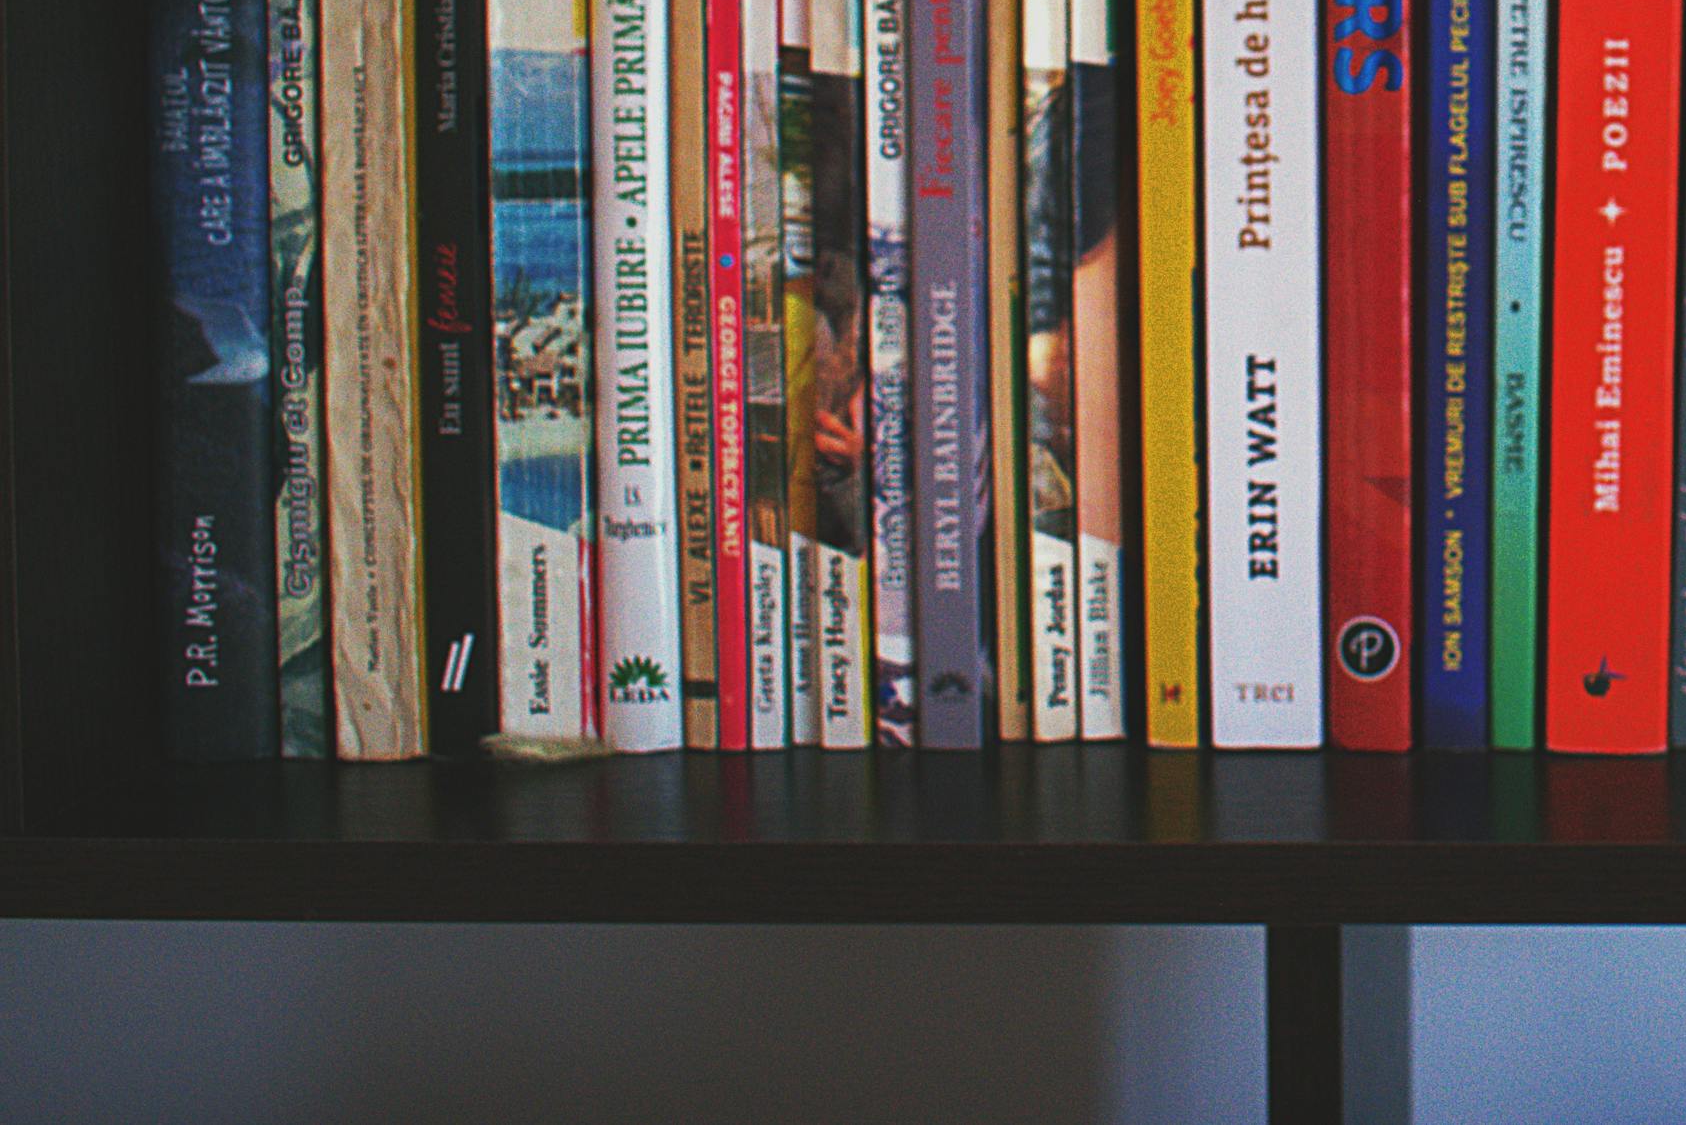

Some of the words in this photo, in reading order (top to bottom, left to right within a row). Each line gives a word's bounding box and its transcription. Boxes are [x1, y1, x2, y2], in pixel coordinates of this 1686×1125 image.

[435, 71, 458, 133] Maria
[876, 41, 902, 161] GRIGORE
[1233, 33, 1270, 79] de
[1600, 37, 1630, 172] POEZII
[281, 48, 305, 168] GRIGORE
[613, 106, 647, 208] APELE
[1447, 57, 1470, 174] FLAGELUL
[717, 152, 735, 219] ALESE
[1236, 89, 1281, 251] Prințesa
[1447, 180, 1469, 228] SUB
[1508, 89, 1528, 243] ISPIRESCU
[614, 236, 648, 353] IUBIRE
[718, 295, 738, 393] GEORGE
[1594, 246, 1625, 409] Eminescu
[437, 339, 461, 396] sunt
[616, 363, 650, 468] PRIMA
[929, 281, 961, 483] BAINBRIDGE
[1245, 354, 1277, 468] WATT
[1444, 362, 1467, 394] DE
[437, 401, 462, 436] Eu
[1443, 397, 1465, 500] VREMURI
[1593, 419, 1622, 513] Mihai
[184, 515, 219, 628] Morrison
[685, 490, 709, 561] ALEXE
[932, 491, 961, 591] BERYL
[1247, 480, 1279, 581] ERIN
[528, 545, 549, 650] Summers
[821, 555, 849, 648] Hughes
[1442, 529, 1464, 626] SAMSON
[184, 635, 219, 687] P.R.
[825, 655, 850, 722] Tracy
[1442, 631, 1464, 672] ION
